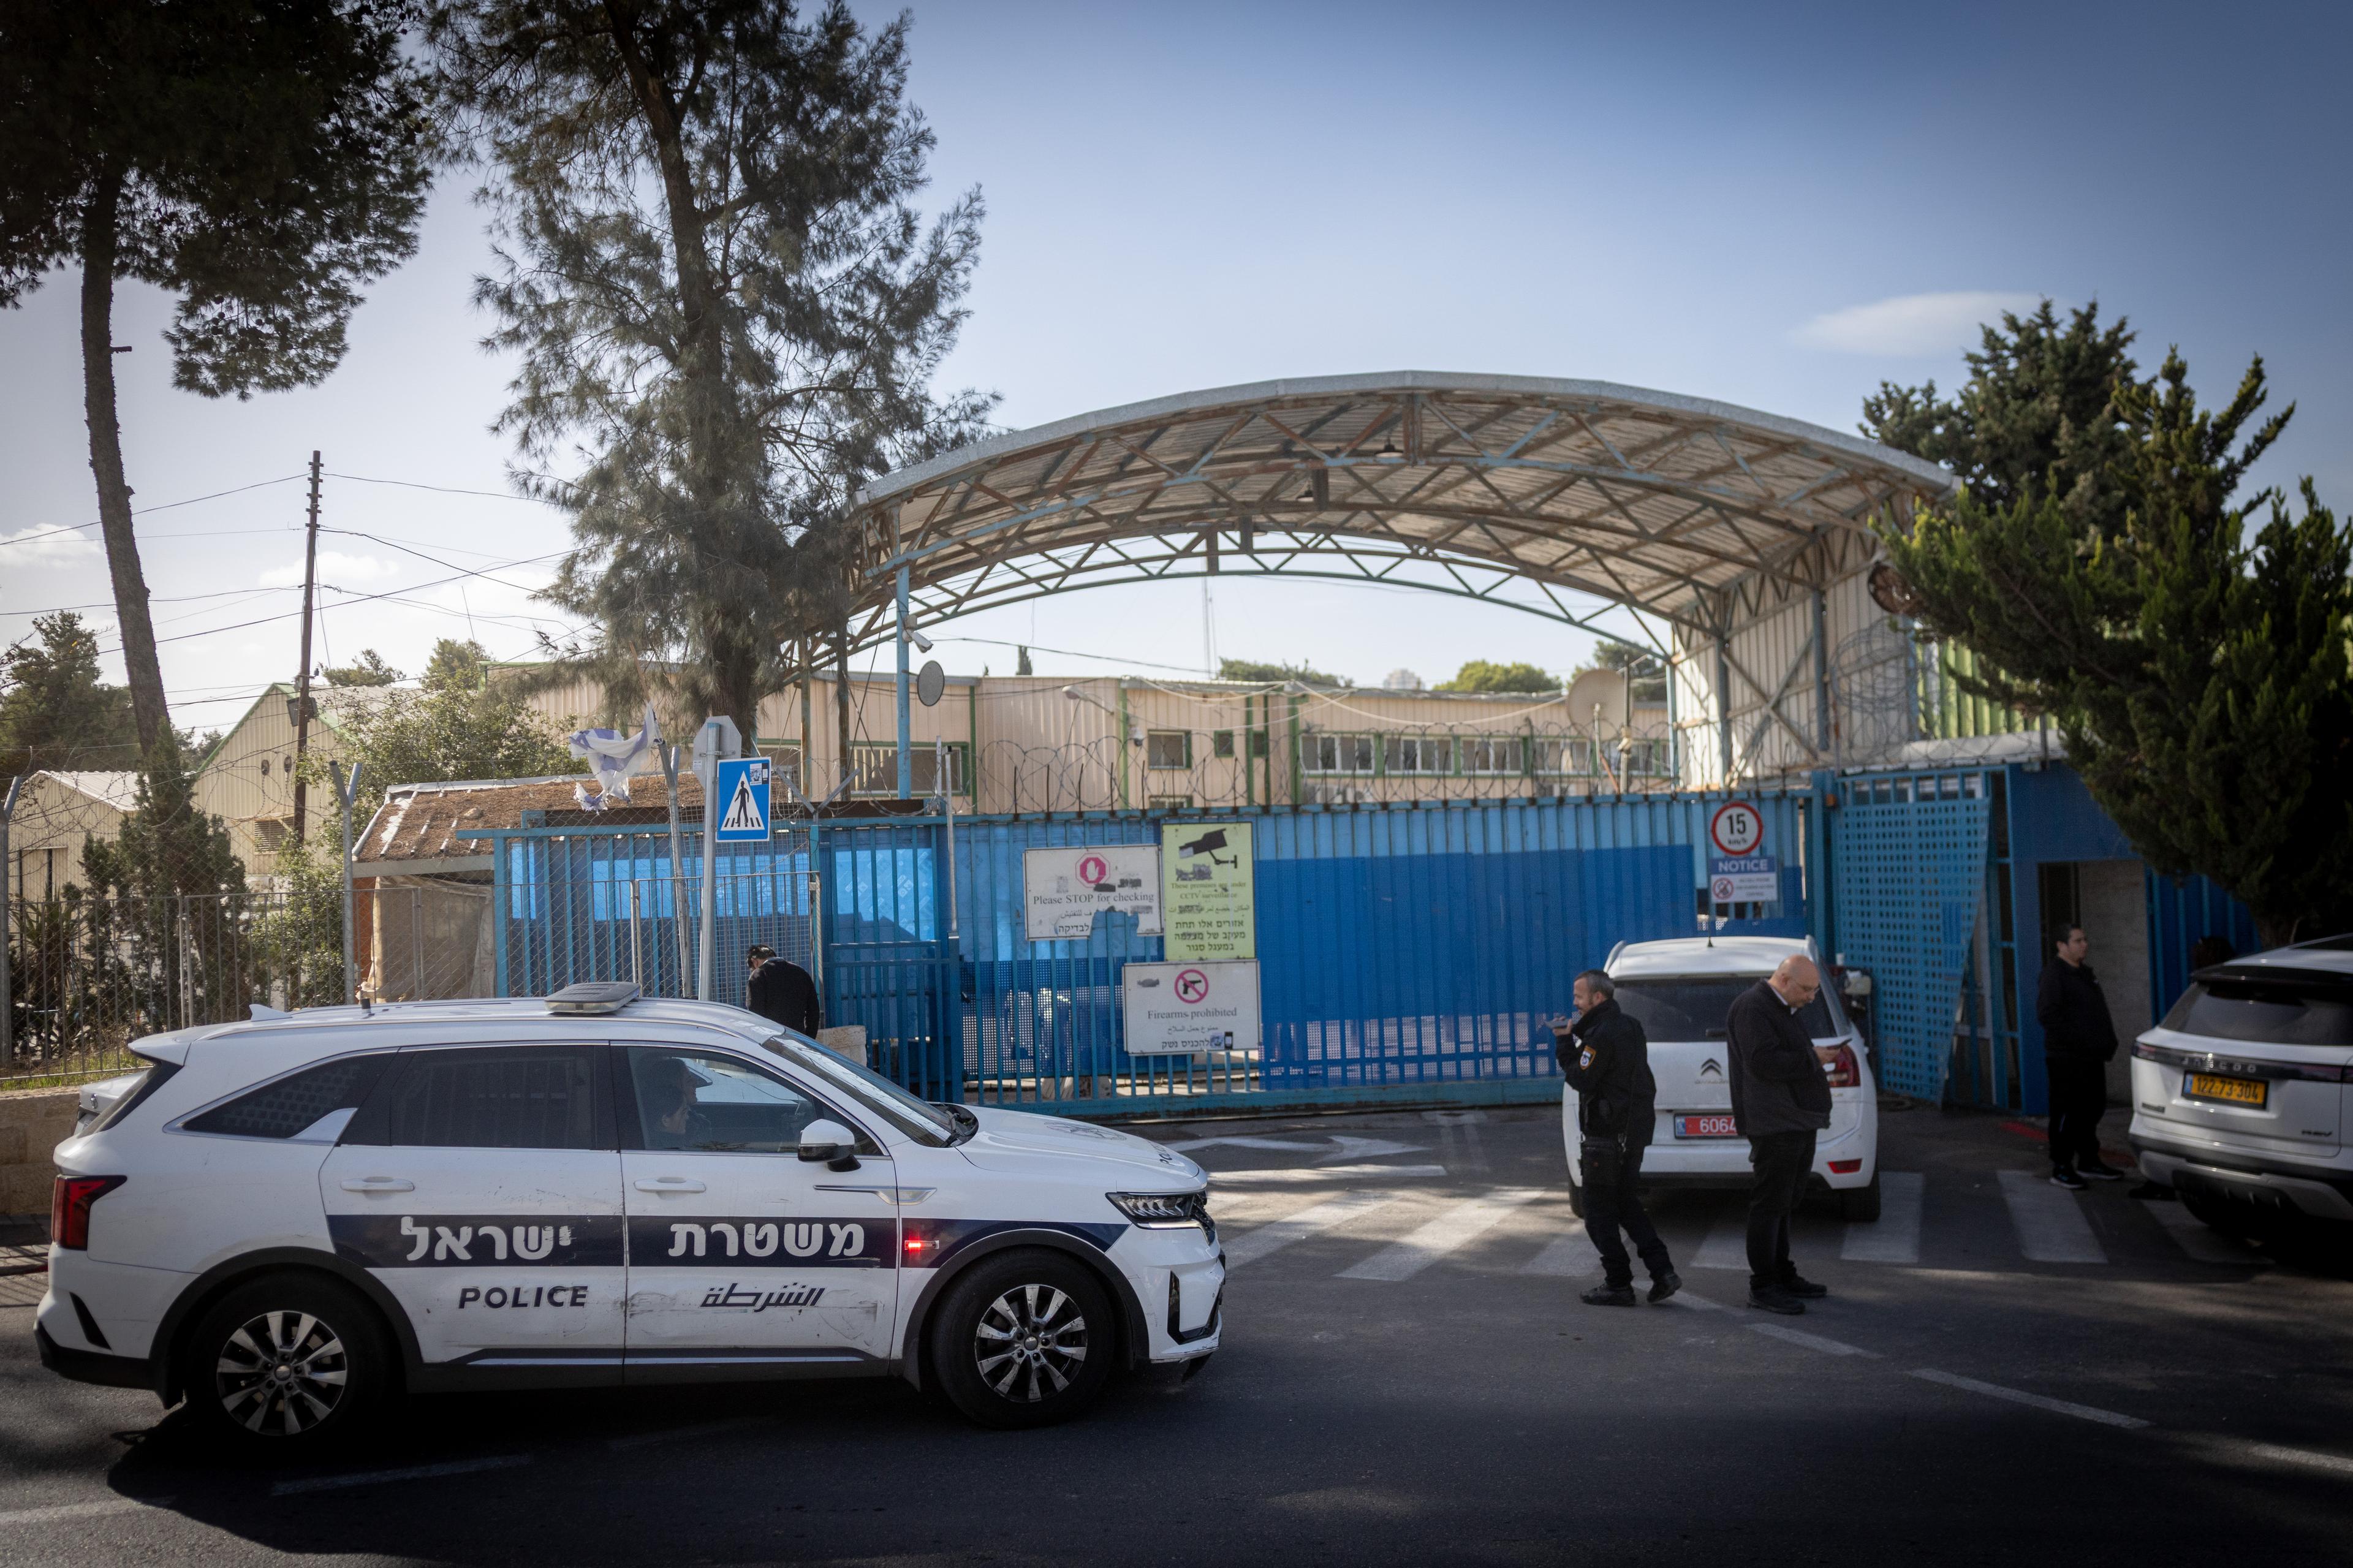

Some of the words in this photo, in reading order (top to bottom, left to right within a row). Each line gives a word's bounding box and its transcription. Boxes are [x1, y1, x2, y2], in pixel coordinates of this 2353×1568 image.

[1727, 813, 1746, 835] 15
[1718, 859, 1768, 873] NOTICE
[1034, 896, 1062, 904] Please
[1066, 894, 1094, 904] STOP
[1097, 893, 1110, 902] for
[1113, 892, 1154, 903] checking
[1059, 924, 1089, 934] לבדיקה
[1198, 919, 1212, 928] אלו
[1207, 930, 1219, 939] של
[1208, 942, 1234, 951] במעגל
[1148, 1010, 1186, 1019] Firearms
[1191, 1007, 1237, 1020] prohibited
[1168, 1025, 1185, 1034] السلاح
[1162, 1040, 1178, 1050] נשק
[1181, 1038, 1210, 1048] להכניס
[401, 1216, 572, 1261] ישראל
[668, 1223, 865, 1257] משטרת
[459, 1286, 589, 1309] POLICE
[700, 1282, 826, 1312] الشرطة
